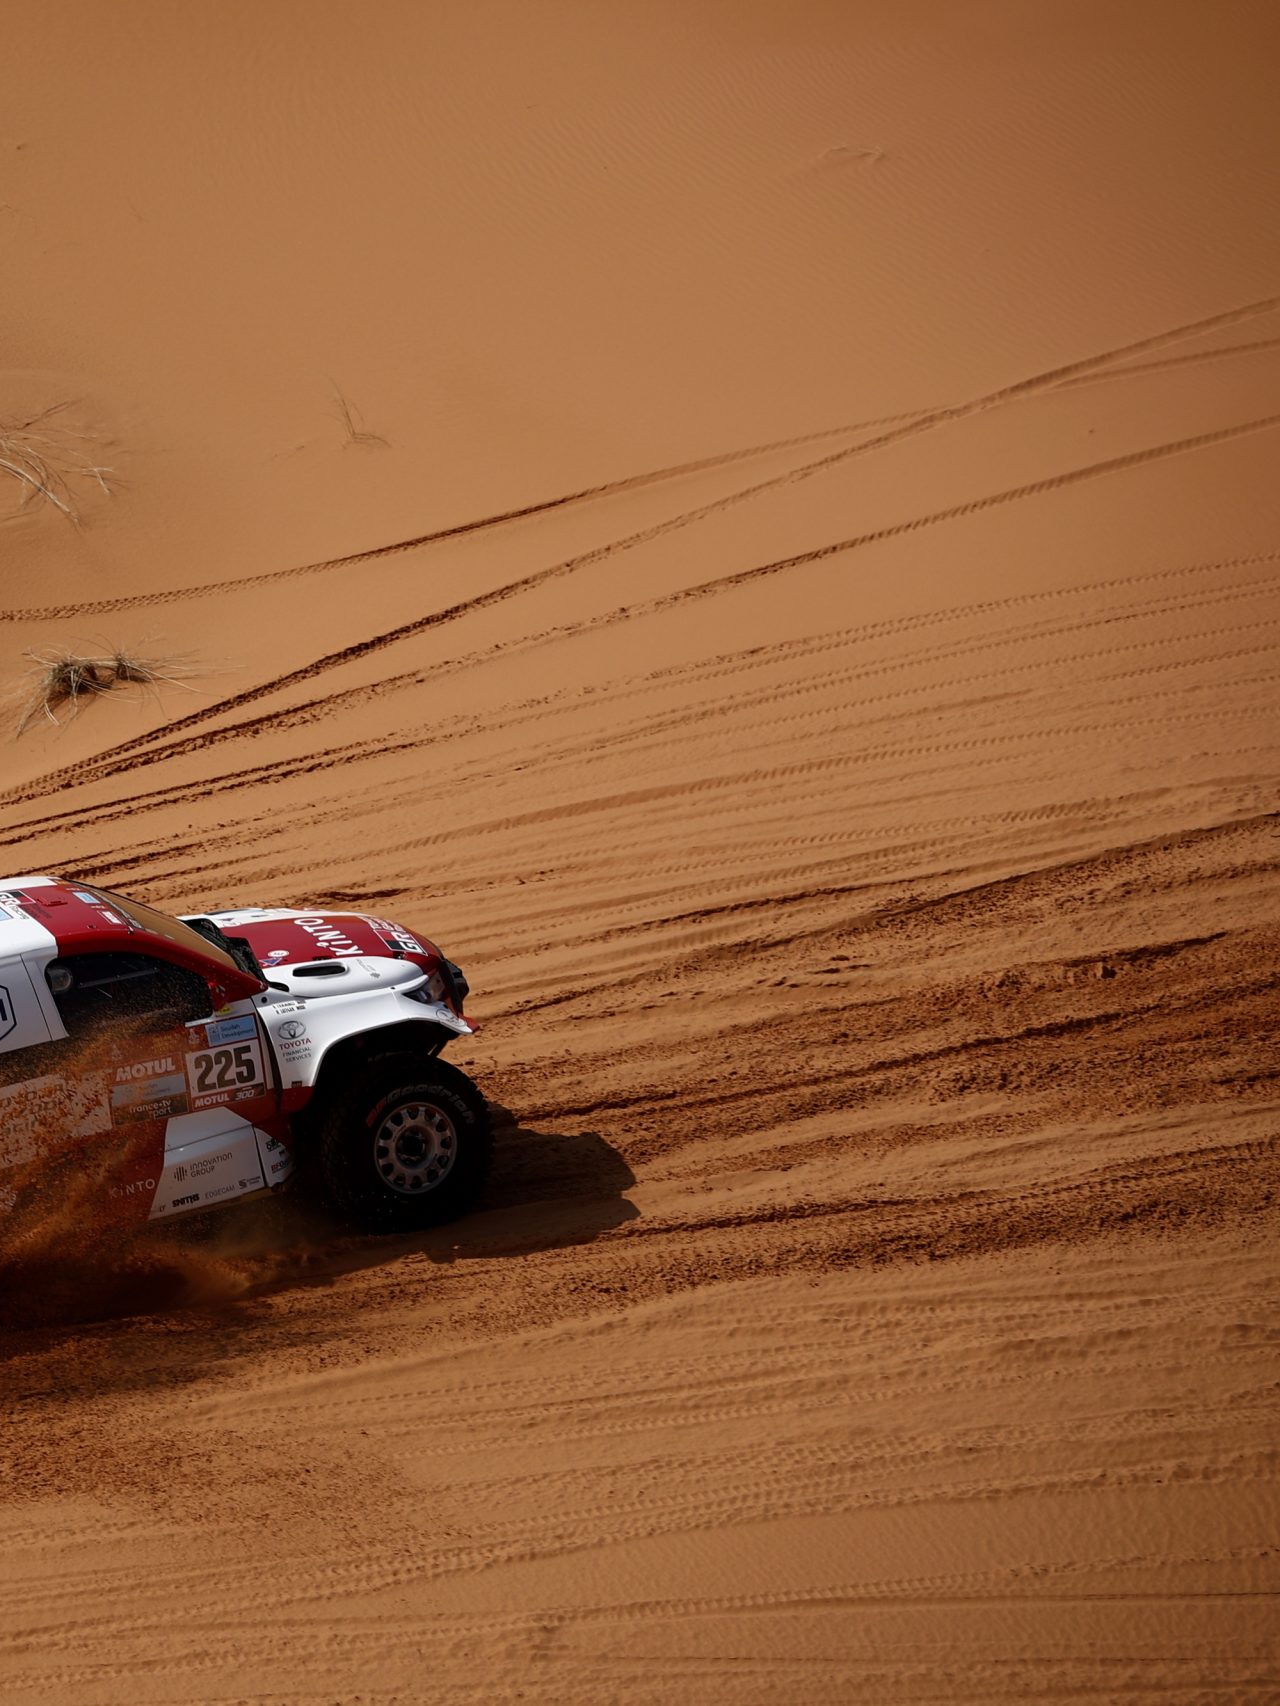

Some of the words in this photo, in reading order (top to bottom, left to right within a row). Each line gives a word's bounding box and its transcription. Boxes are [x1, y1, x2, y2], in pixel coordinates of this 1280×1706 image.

[279, 1038, 312, 1051] TOYOTA
[282, 1047, 312, 1057] FINANCIAL
[285, 1053, 312, 1063] SERVICES
[116, 1057, 176, 1082] MOTUL
[194, 1044, 256, 1093] 225
[195, 1093, 230, 1108] MOTUL
[190, 1165, 216, 1178] GROUP
